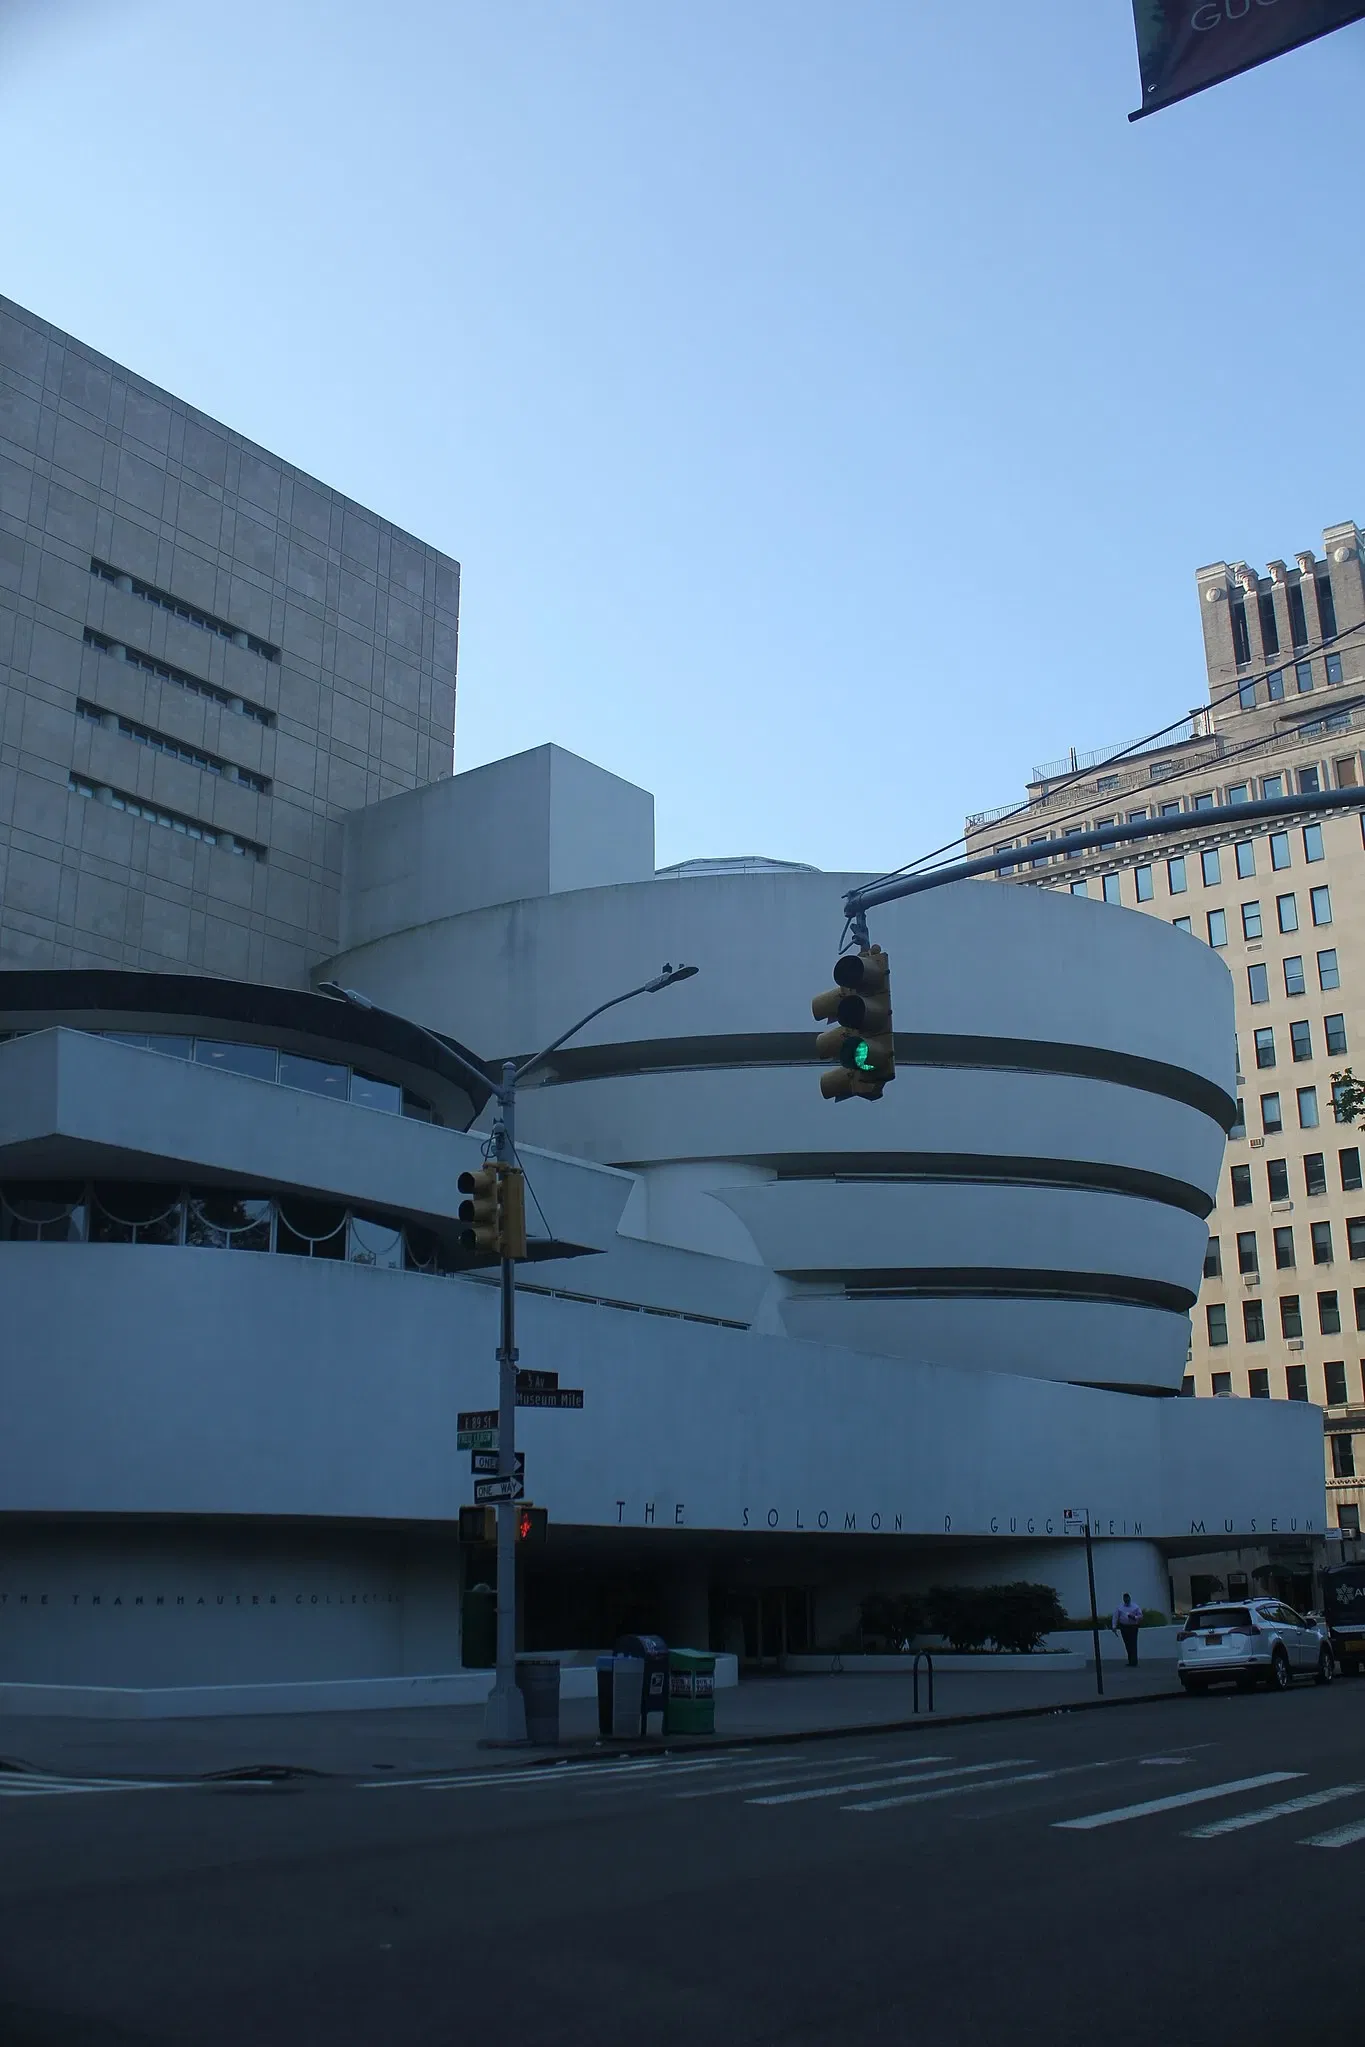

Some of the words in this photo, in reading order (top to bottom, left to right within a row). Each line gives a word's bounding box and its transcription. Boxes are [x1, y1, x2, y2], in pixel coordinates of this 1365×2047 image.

[1190, 0, 1280, 31] GU
[516, 1392, 557, 1406] Museum
[561, 1393, 582, 1407] Mile
[472, 1416, 482, 1429] 89
[483, 1415, 491, 1428] St
[478, 1485, 492, 1497] ONE
[500, 1482, 517, 1495] WAY
[616, 1501, 685, 1525] THE
[742, 1507, 904, 1531] SOLOMON
[944, 1515, 952, 1533] R
[1190, 1517, 1314, 1534] MUSEUM
[0, 1593, 49, 1606] THE
